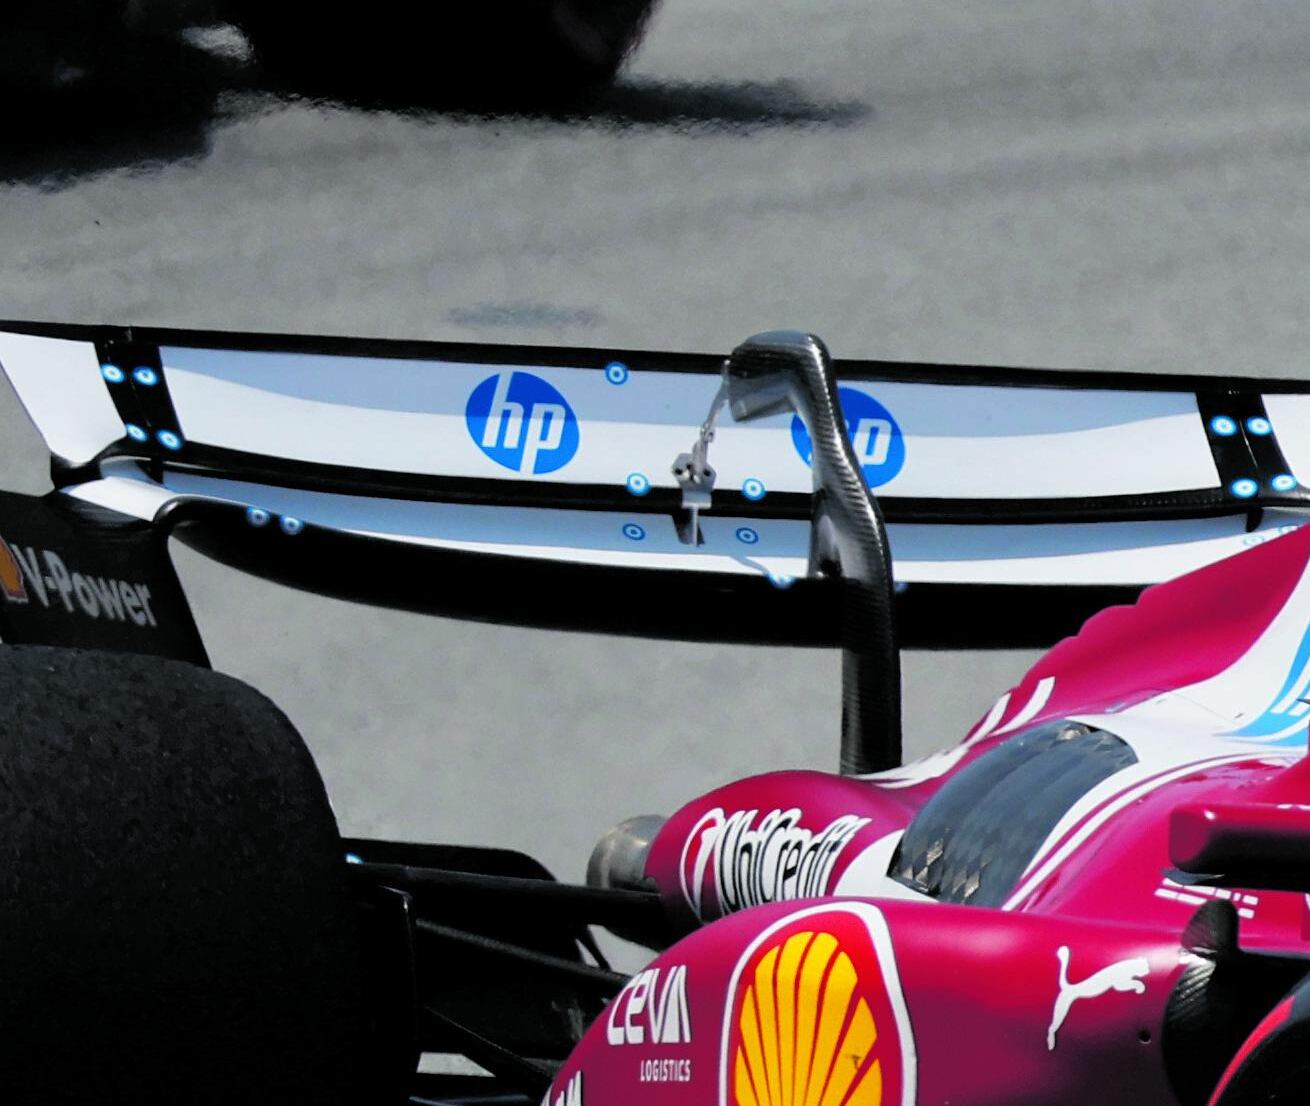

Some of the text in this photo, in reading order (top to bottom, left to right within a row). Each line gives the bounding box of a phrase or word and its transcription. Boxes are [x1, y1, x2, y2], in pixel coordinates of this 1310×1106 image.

[477, 370, 571, 475] hp
[9, 543, 158, 627] V-Power
[639, 1059, 691, 1082] LOGISTICS
